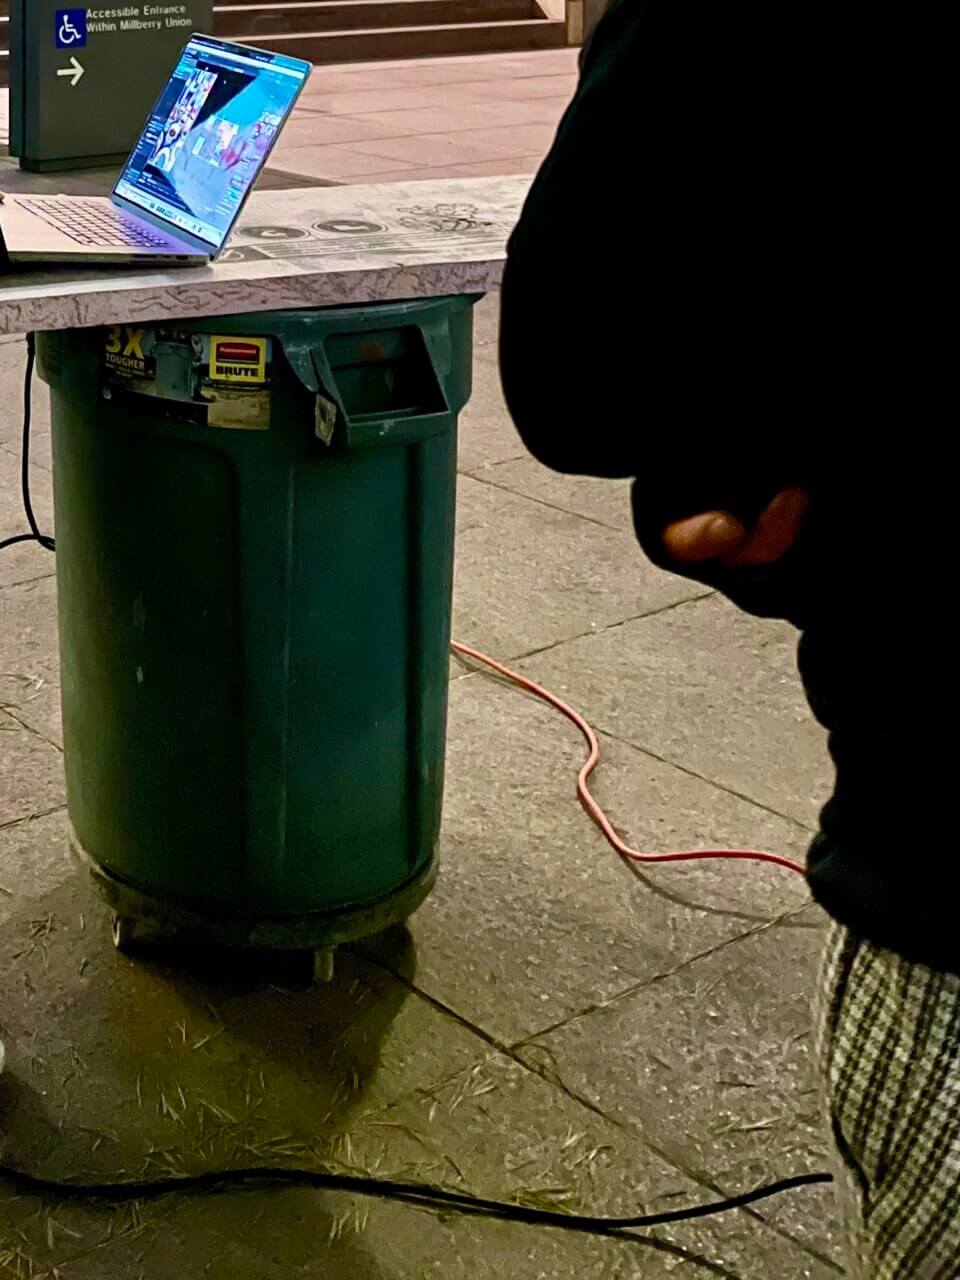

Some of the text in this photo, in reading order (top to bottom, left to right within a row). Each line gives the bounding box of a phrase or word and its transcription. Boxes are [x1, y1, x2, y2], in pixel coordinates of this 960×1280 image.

[86, 4, 186, 19] Accessible Entrance
[86, 17, 192, 33] Within Millberry Union
[104, 325, 145, 360] 3X
[104, 352, 145, 370] TOUGHER
[215, 365, 258, 377] BRUTE
